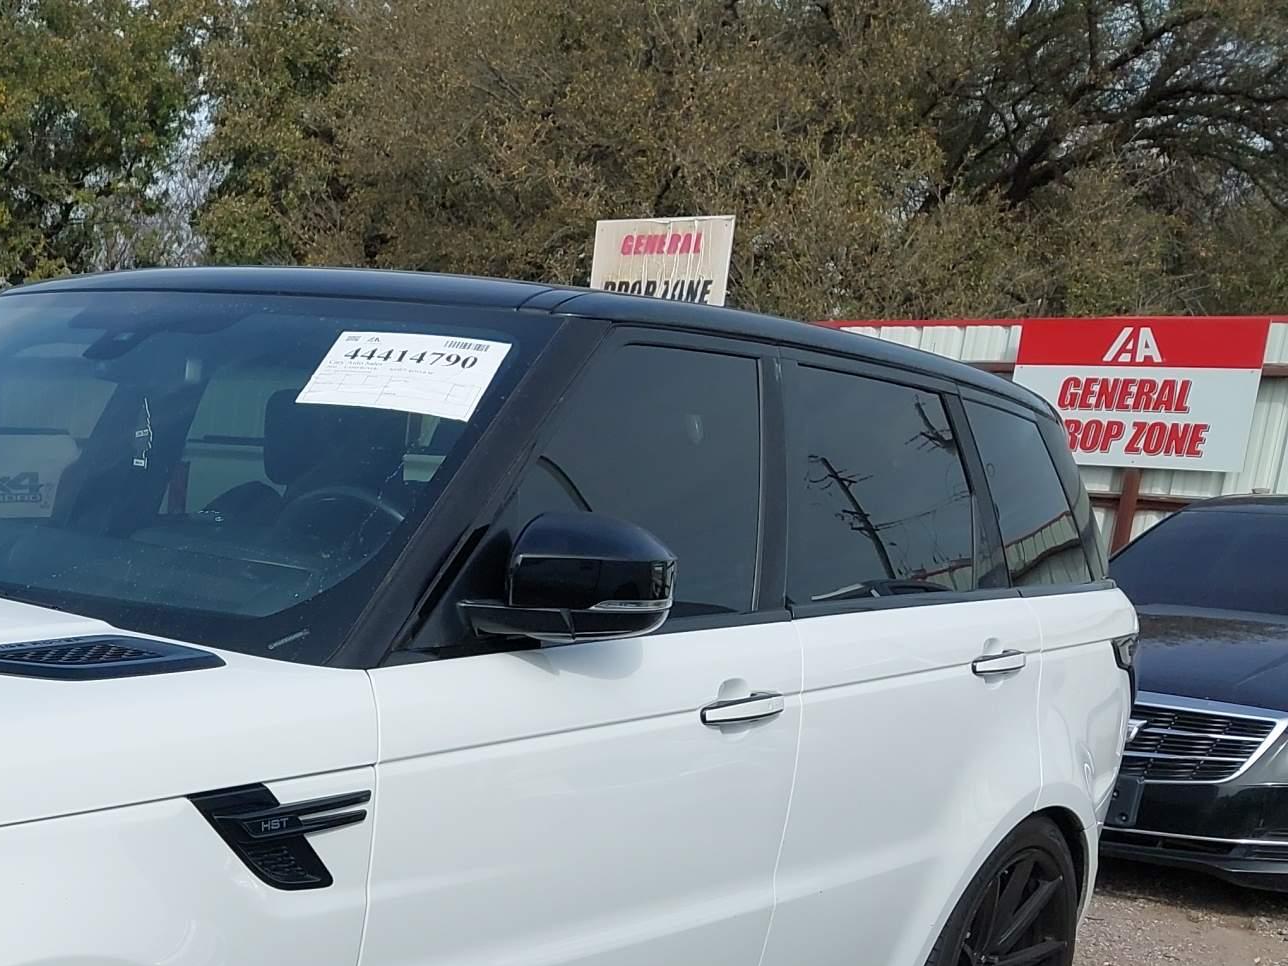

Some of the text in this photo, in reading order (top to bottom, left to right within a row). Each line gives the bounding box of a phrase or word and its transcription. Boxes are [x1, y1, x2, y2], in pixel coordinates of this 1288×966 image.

[620, 231, 703, 257] GENERAL
[343, 346, 479, 369] 44414790
[1057, 376, 1193, 414] GENERAL
[1064, 418, 1210, 458] ROP ZONE
[260, 817, 290, 833] HST
